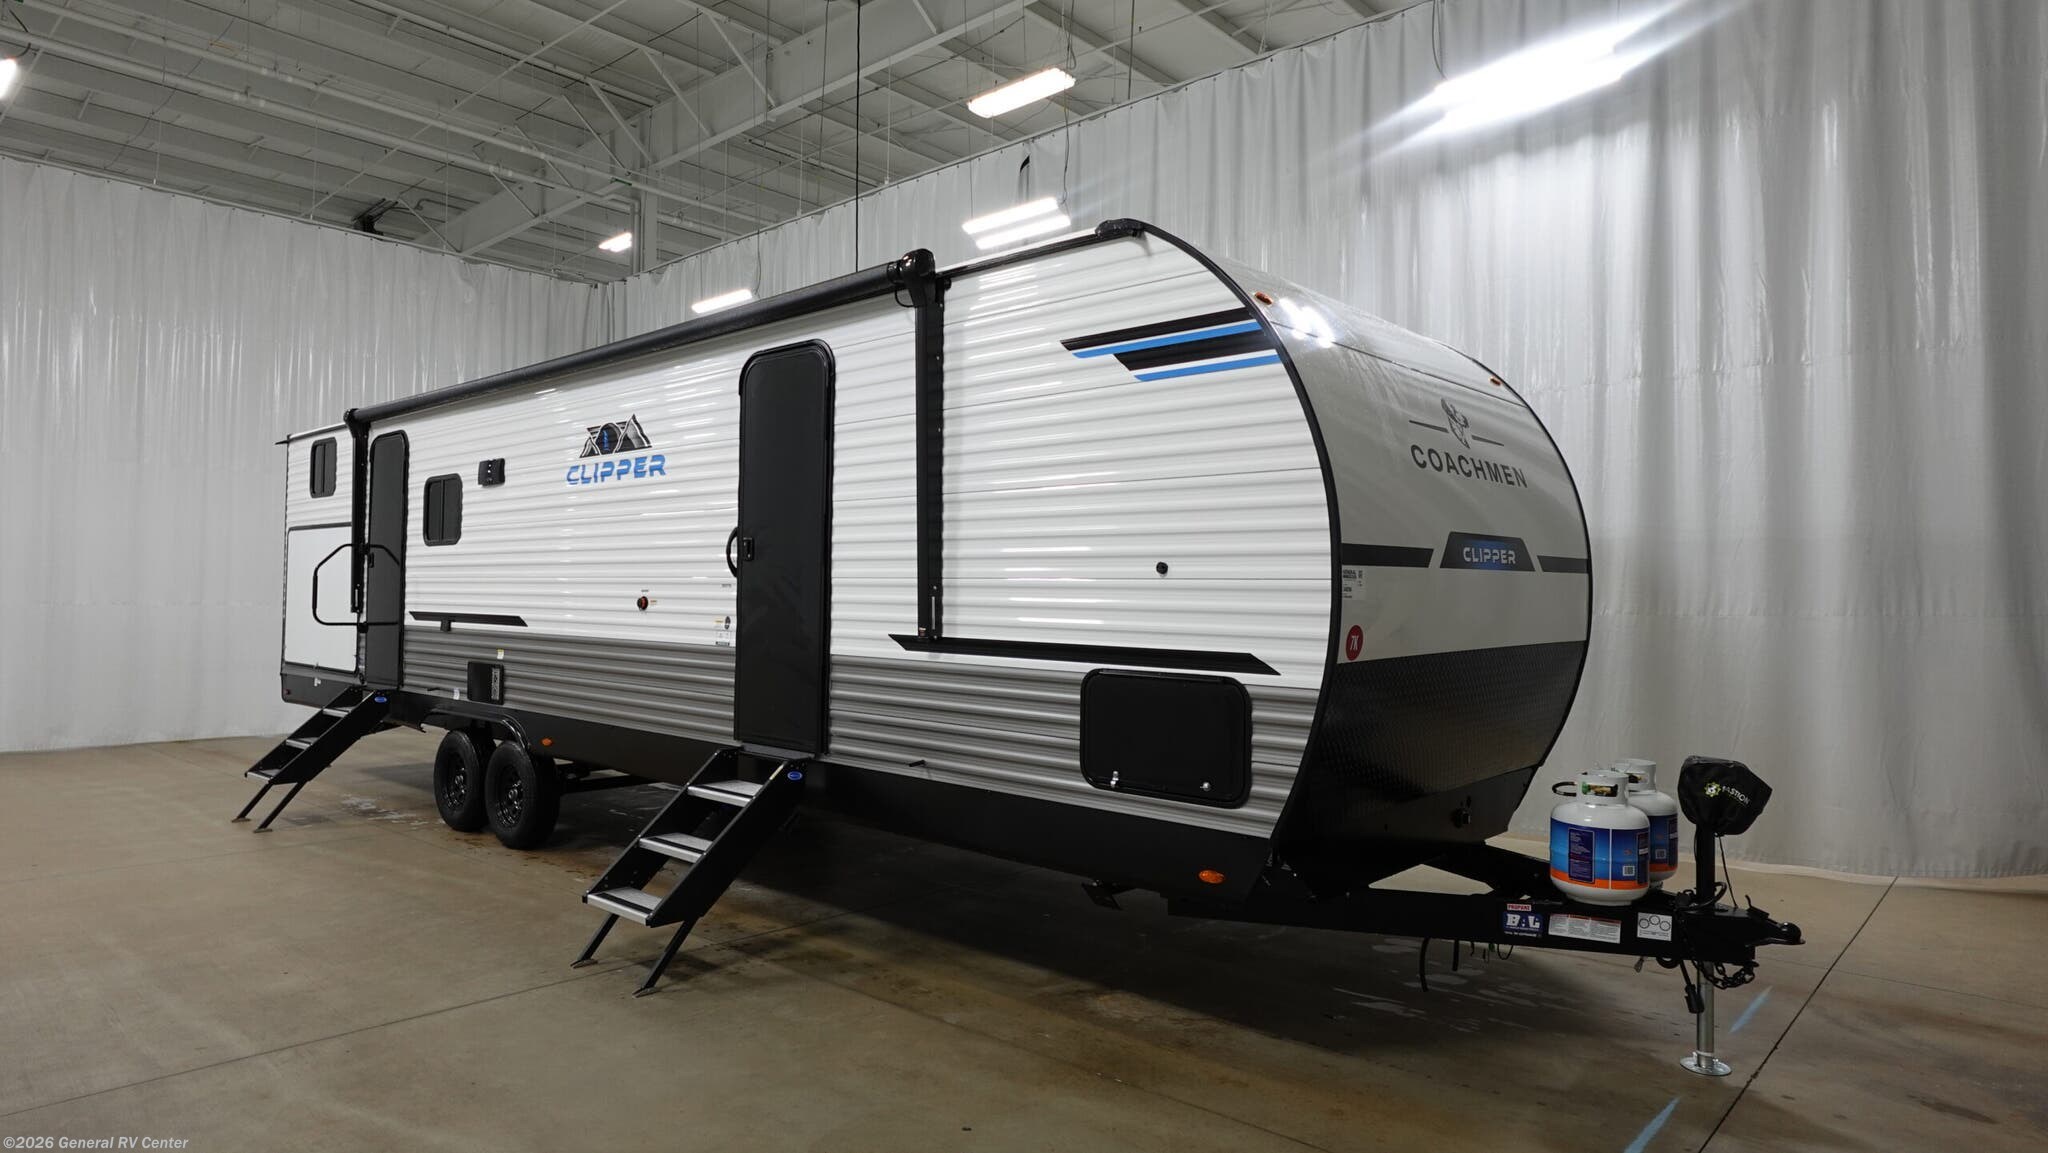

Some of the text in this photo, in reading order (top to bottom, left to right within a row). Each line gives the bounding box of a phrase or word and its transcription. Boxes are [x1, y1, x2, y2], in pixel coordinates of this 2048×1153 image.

[566, 454, 666, 486] CLIPPER
[1410, 443, 1529, 489] COACHMEN
[1463, 546, 1517, 565] CLIPPER
